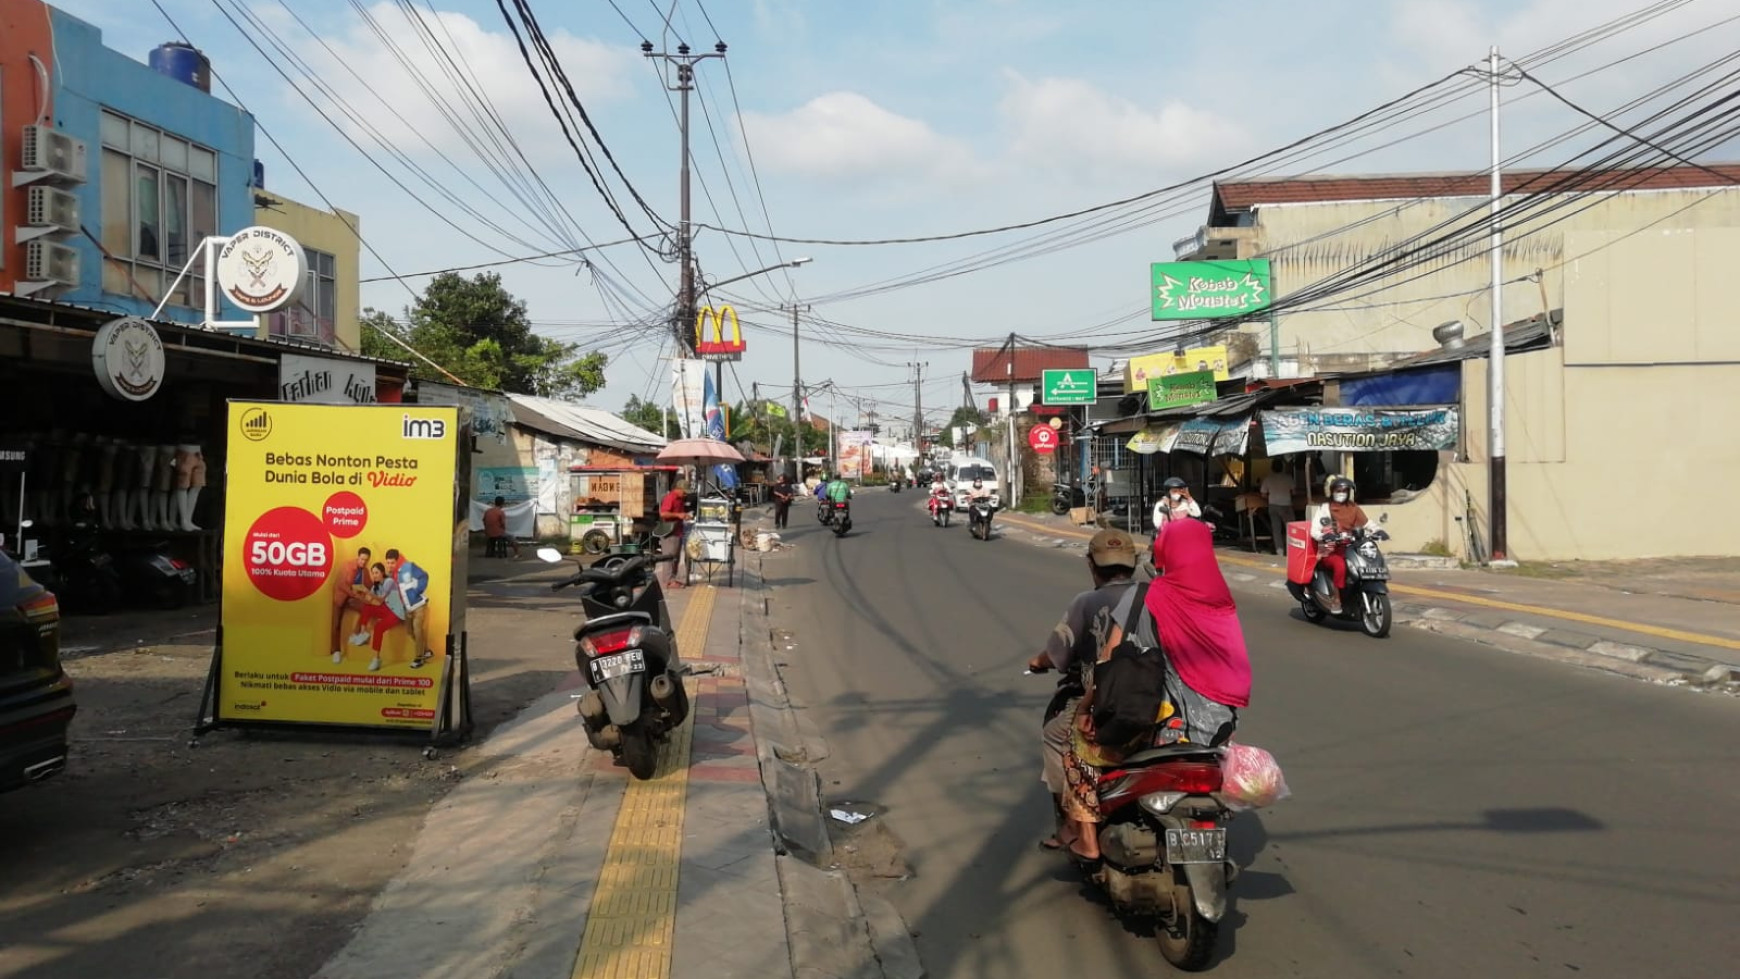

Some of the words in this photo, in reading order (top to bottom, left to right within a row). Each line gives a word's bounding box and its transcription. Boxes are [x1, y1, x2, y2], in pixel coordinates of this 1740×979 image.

[222, 233, 248, 259] VAPER
[253, 230, 294, 256] DISTRICT
[1188, 276, 1238, 292] Kebab
[1177, 294, 1248, 310] Monster
[109, 322, 130, 346] VAPER
[132, 321, 162, 350] DISTRICT
[1322, 413, 1377, 428] BERAS
[1306, 432, 1376, 447] NASUTION
[1379, 432, 1416, 447] JAYA
[266, 452, 312, 466] Bebas
[316, 454, 371, 468] Nonton
[376, 456, 418, 469] Pesta
[265, 470, 307, 484] Dunia
[312, 471, 345, 485] Bola
[349, 472, 362, 486] di
[366, 470, 418, 488] Vidio
[326, 506, 364, 516] Postpaid
[333, 517, 359, 526] Prime
[251, 540, 326, 566] 50GB
[251, 568, 272, 576] 100%
[274, 568, 296, 577] Kuota
[298, 569, 325, 578] Utama
[234, 671, 264, 679] Berlaku
[266, 672, 288, 680] untuk
[318, 674, 351, 684] Postpaid
[352, 676, 374, 684] mulai
[418, 678, 430, 686] 100
[274, 682, 296, 690] bebas
[322, 684, 340, 692] Vidio
[356, 686, 384, 694] mobile
[402, 688, 425, 696] tablet
[1170, 832, 1178, 846] B
